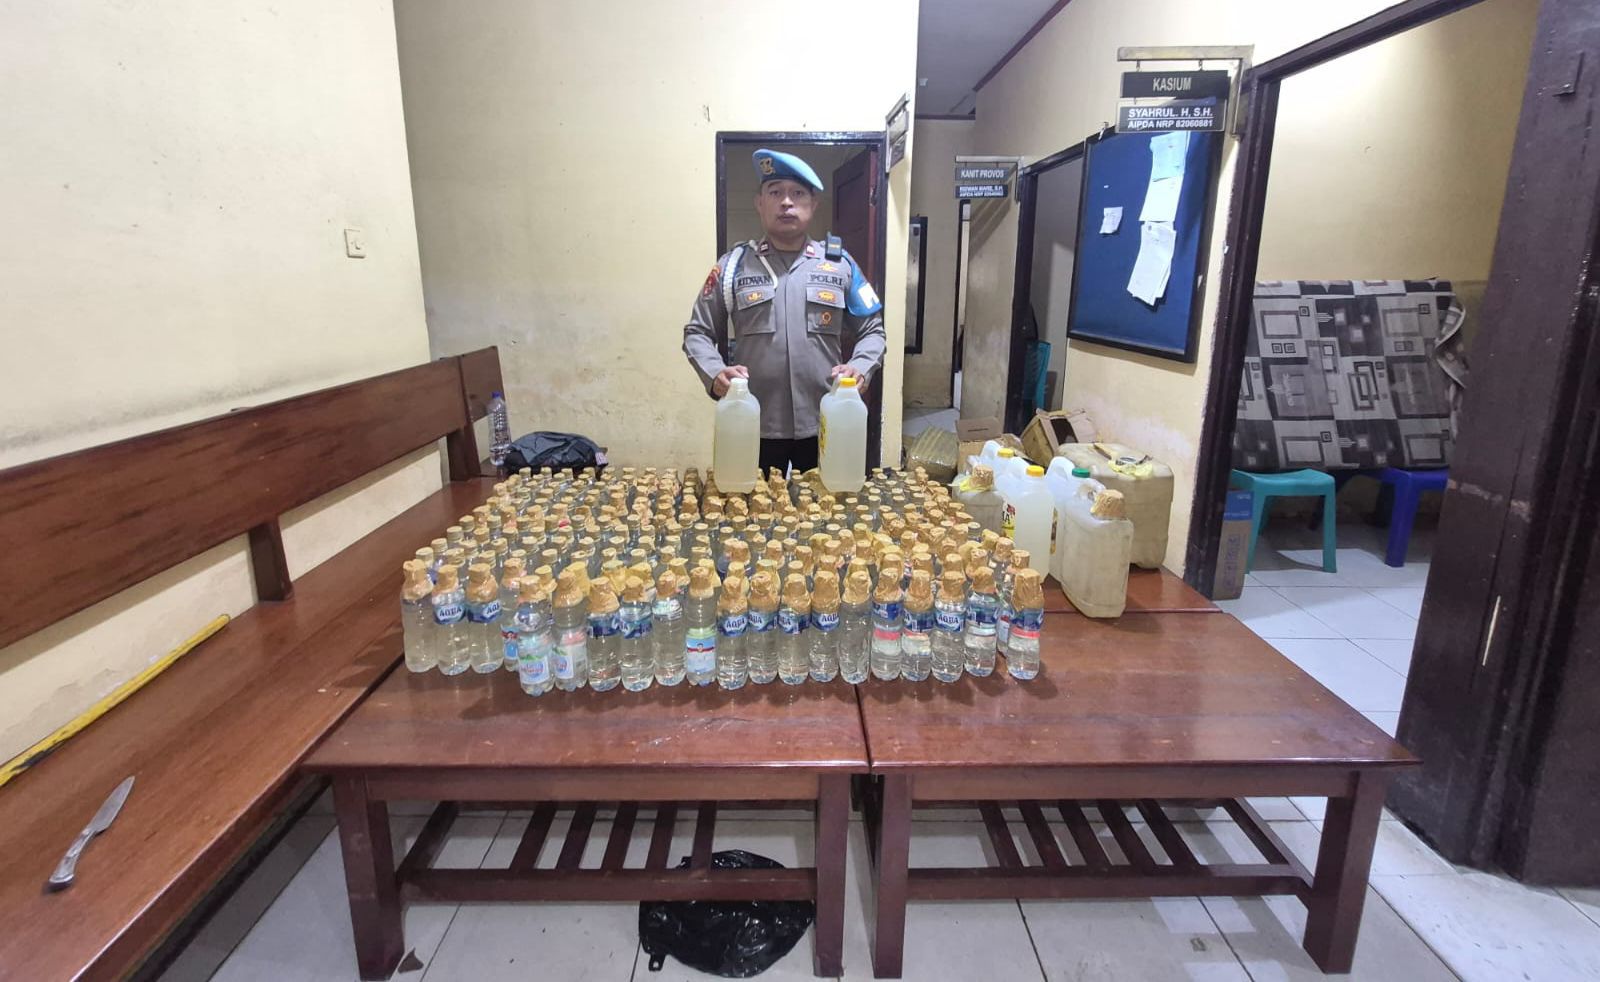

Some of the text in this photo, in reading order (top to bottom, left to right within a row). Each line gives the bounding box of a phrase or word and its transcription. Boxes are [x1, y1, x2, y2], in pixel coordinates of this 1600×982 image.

[1153, 77, 1192, 91] KASIUM
[1128, 107, 1178, 118] SYAHRUL.
[1127, 120, 1154, 129] AIPDA
[1155, 120, 1174, 128] NRP
[961, 169, 1004, 178] KANIT PROVOS
[738, 275, 771, 287] RIDWAN
[810, 274, 843, 286] POLRI
[938, 614, 959, 624] AQUA
